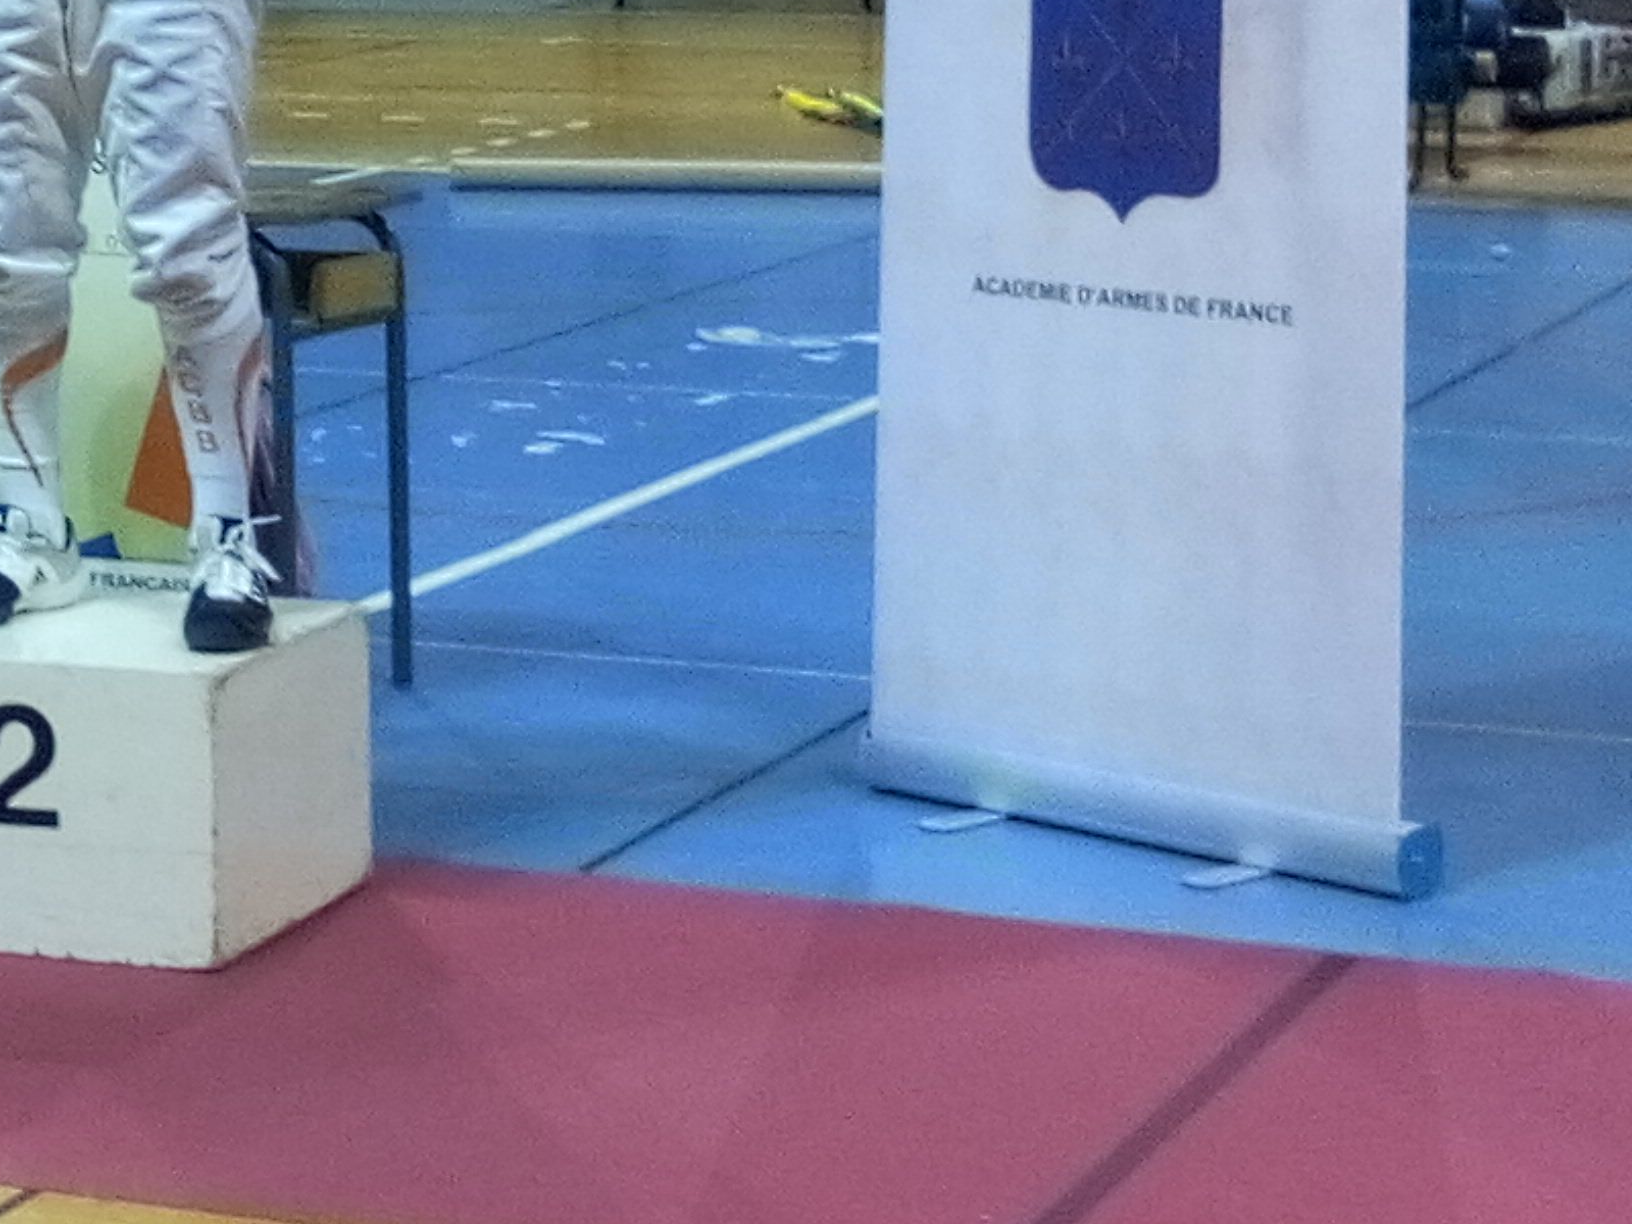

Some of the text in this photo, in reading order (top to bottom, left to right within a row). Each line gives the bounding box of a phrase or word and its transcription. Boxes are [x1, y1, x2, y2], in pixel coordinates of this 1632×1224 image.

[971, 274, 1294, 327] ACADEMIE D'ARMES DE FRANCE
